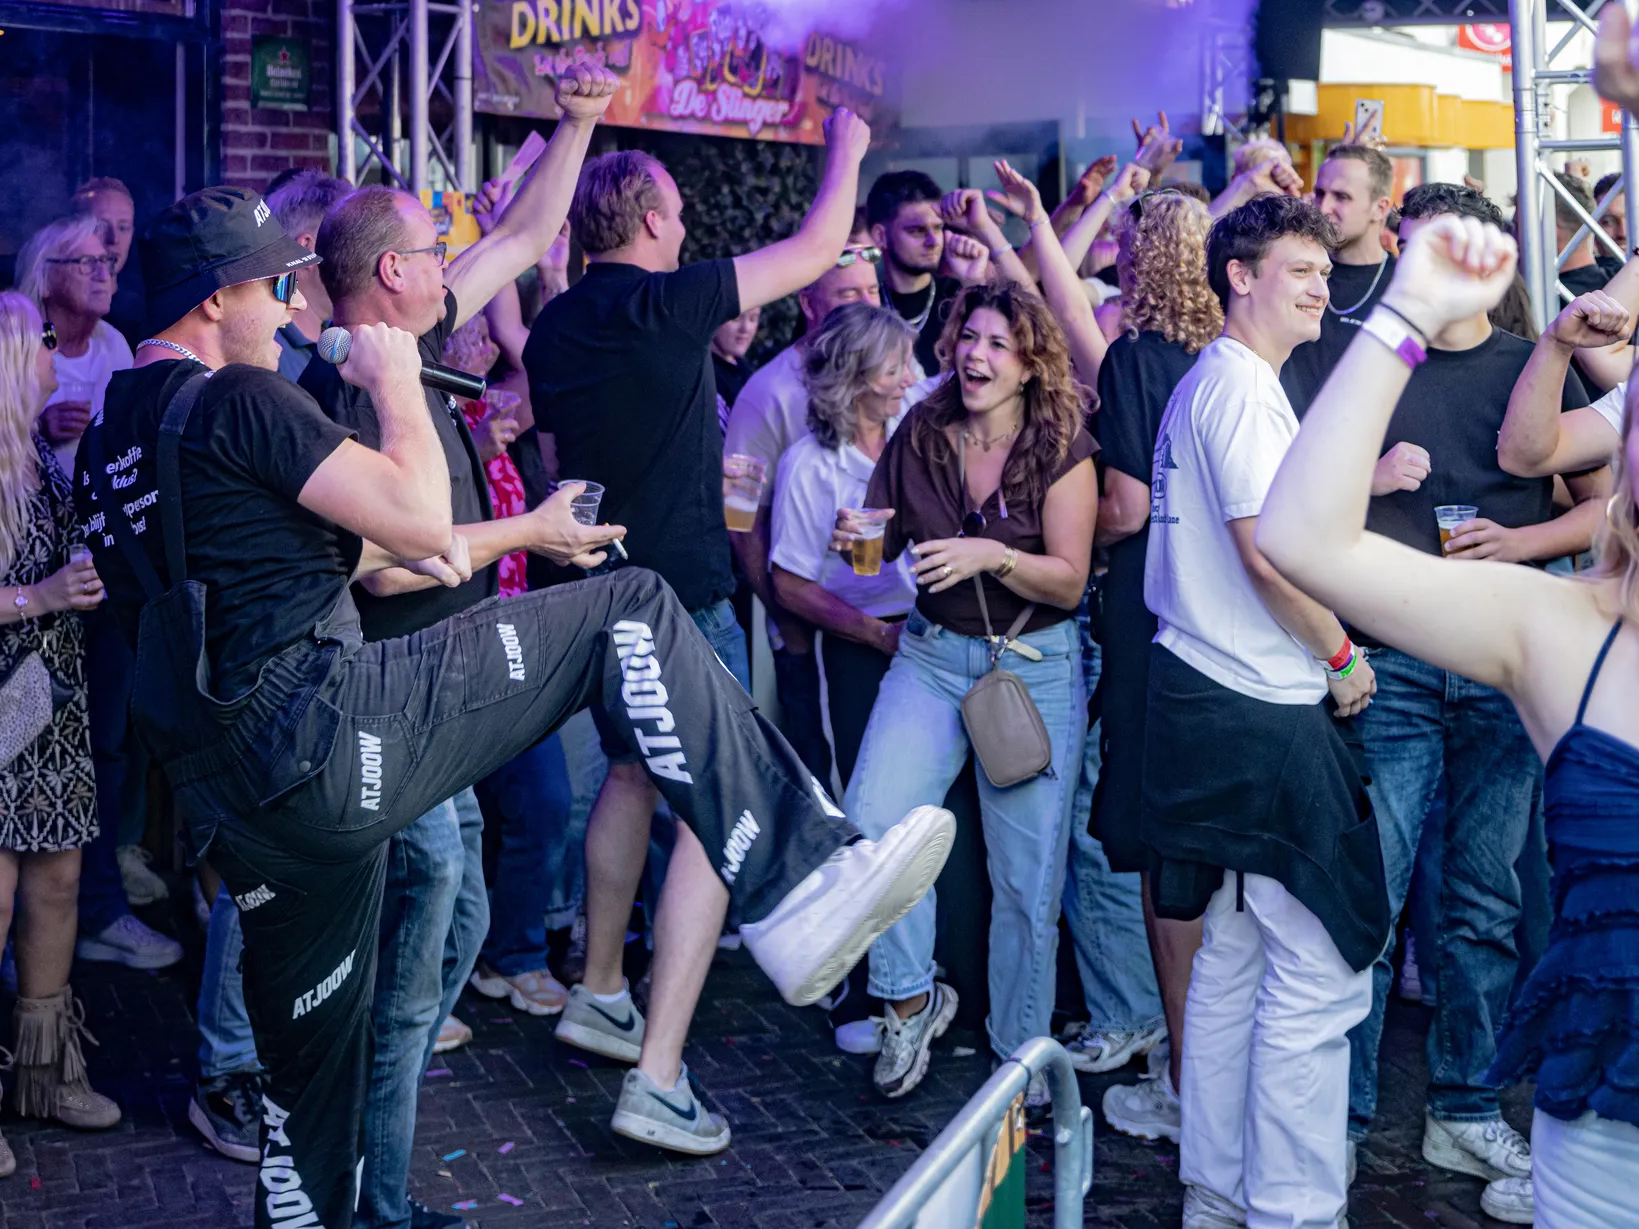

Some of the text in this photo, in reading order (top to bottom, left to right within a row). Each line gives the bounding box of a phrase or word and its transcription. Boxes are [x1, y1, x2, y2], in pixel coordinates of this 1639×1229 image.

[805, 30, 884, 97] DRINKS
[669, 78, 707, 119] De
[710, 82, 789, 137] Slinger
[112, 468, 138, 490] klus?
[496, 623, 526, 681] ATJOOW
[613, 620, 694, 784] ATJOOW
[357, 730, 383, 811] ATJOOW
[292, 948, 357, 1020] ATJOOW
